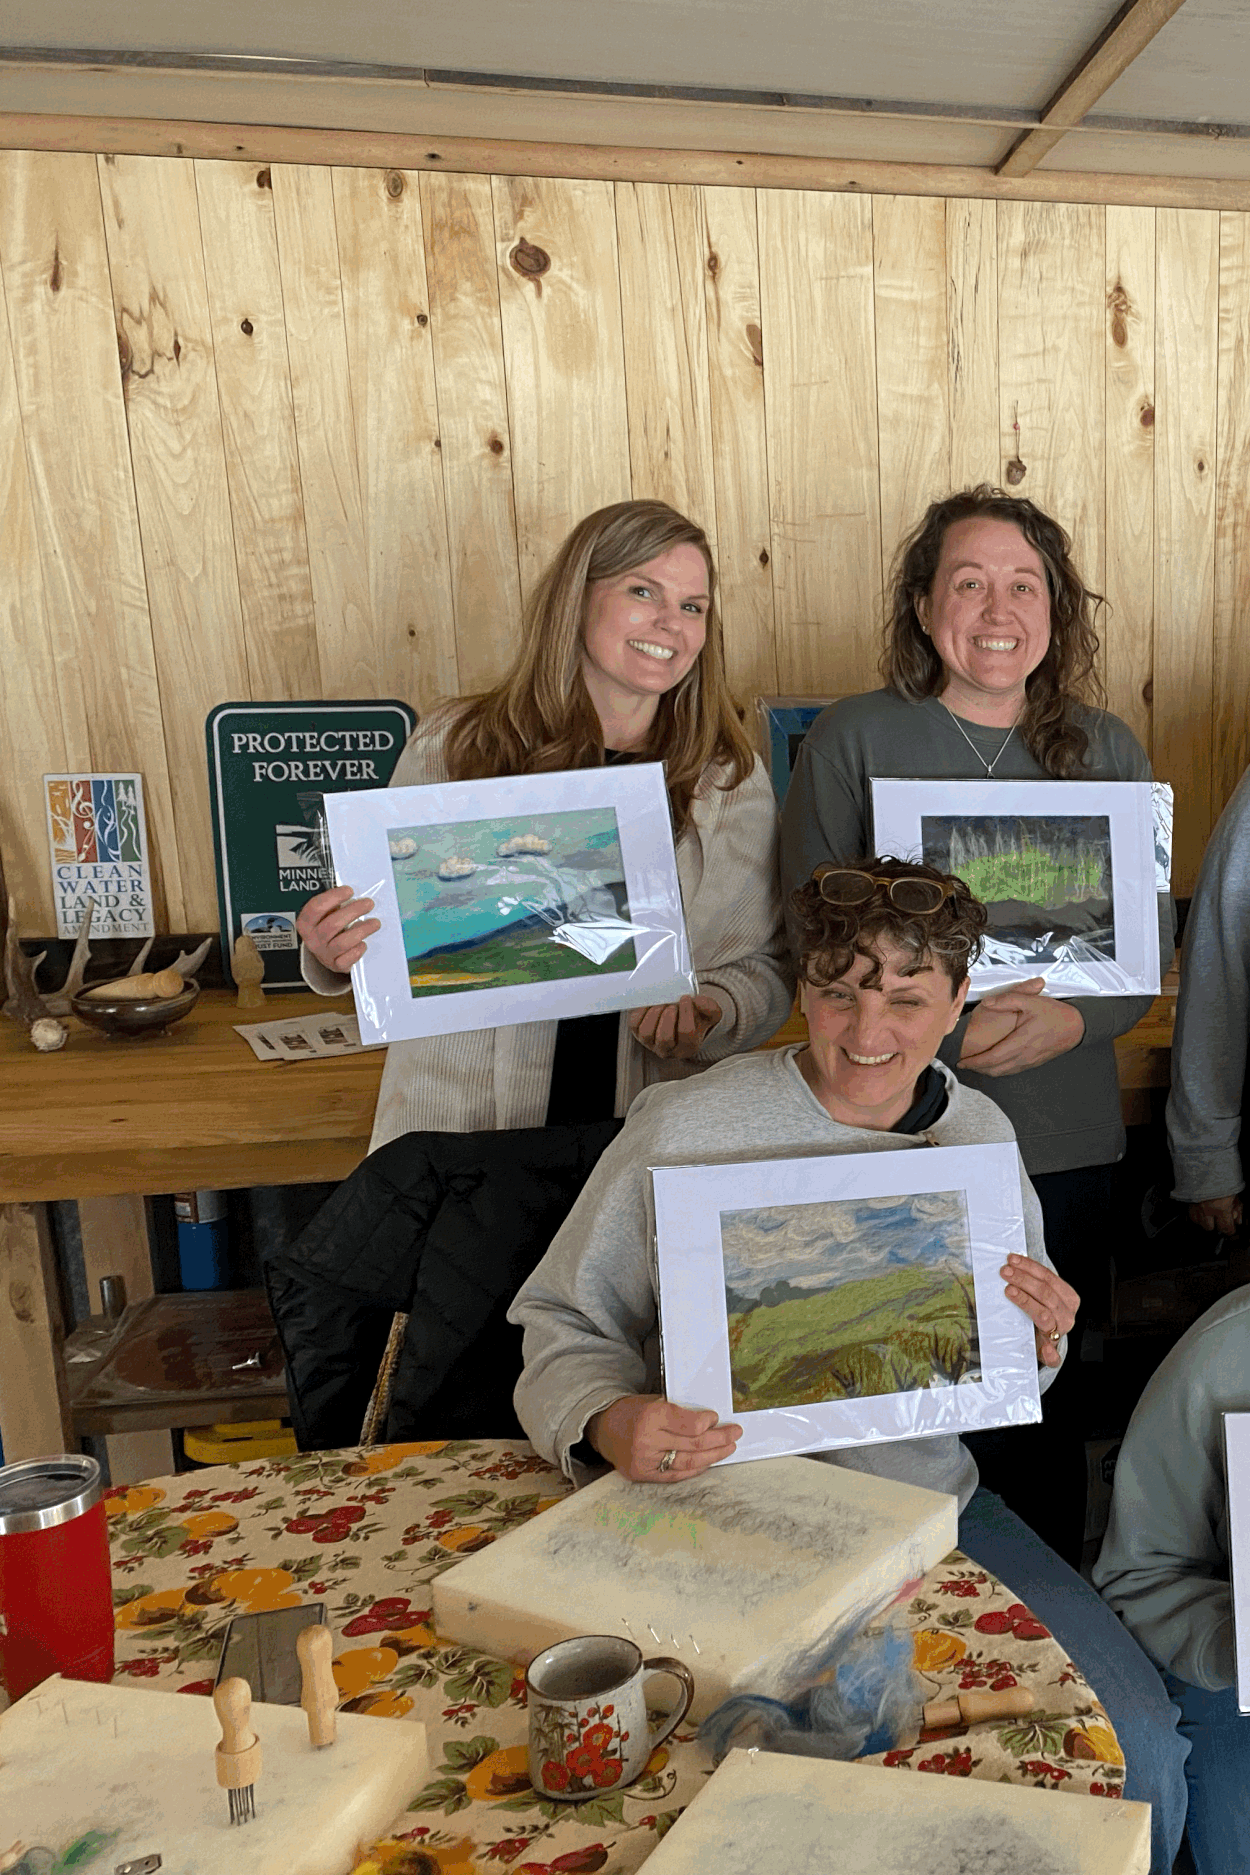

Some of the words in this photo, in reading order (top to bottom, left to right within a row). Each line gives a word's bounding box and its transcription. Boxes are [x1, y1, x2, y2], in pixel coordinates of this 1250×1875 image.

[231, 730, 394, 754] PROTECTED
[252, 759, 379, 782] FOREVER
[57, 864, 142, 879] CLEAN
[58, 879, 145, 894] WATER
[279, 880, 320, 892] LAND
[60, 894, 120, 909] LAND
[129, 893, 145, 907] &
[61, 908, 146, 924] LEGACY
[63, 922, 148, 935] AMNDMENT
